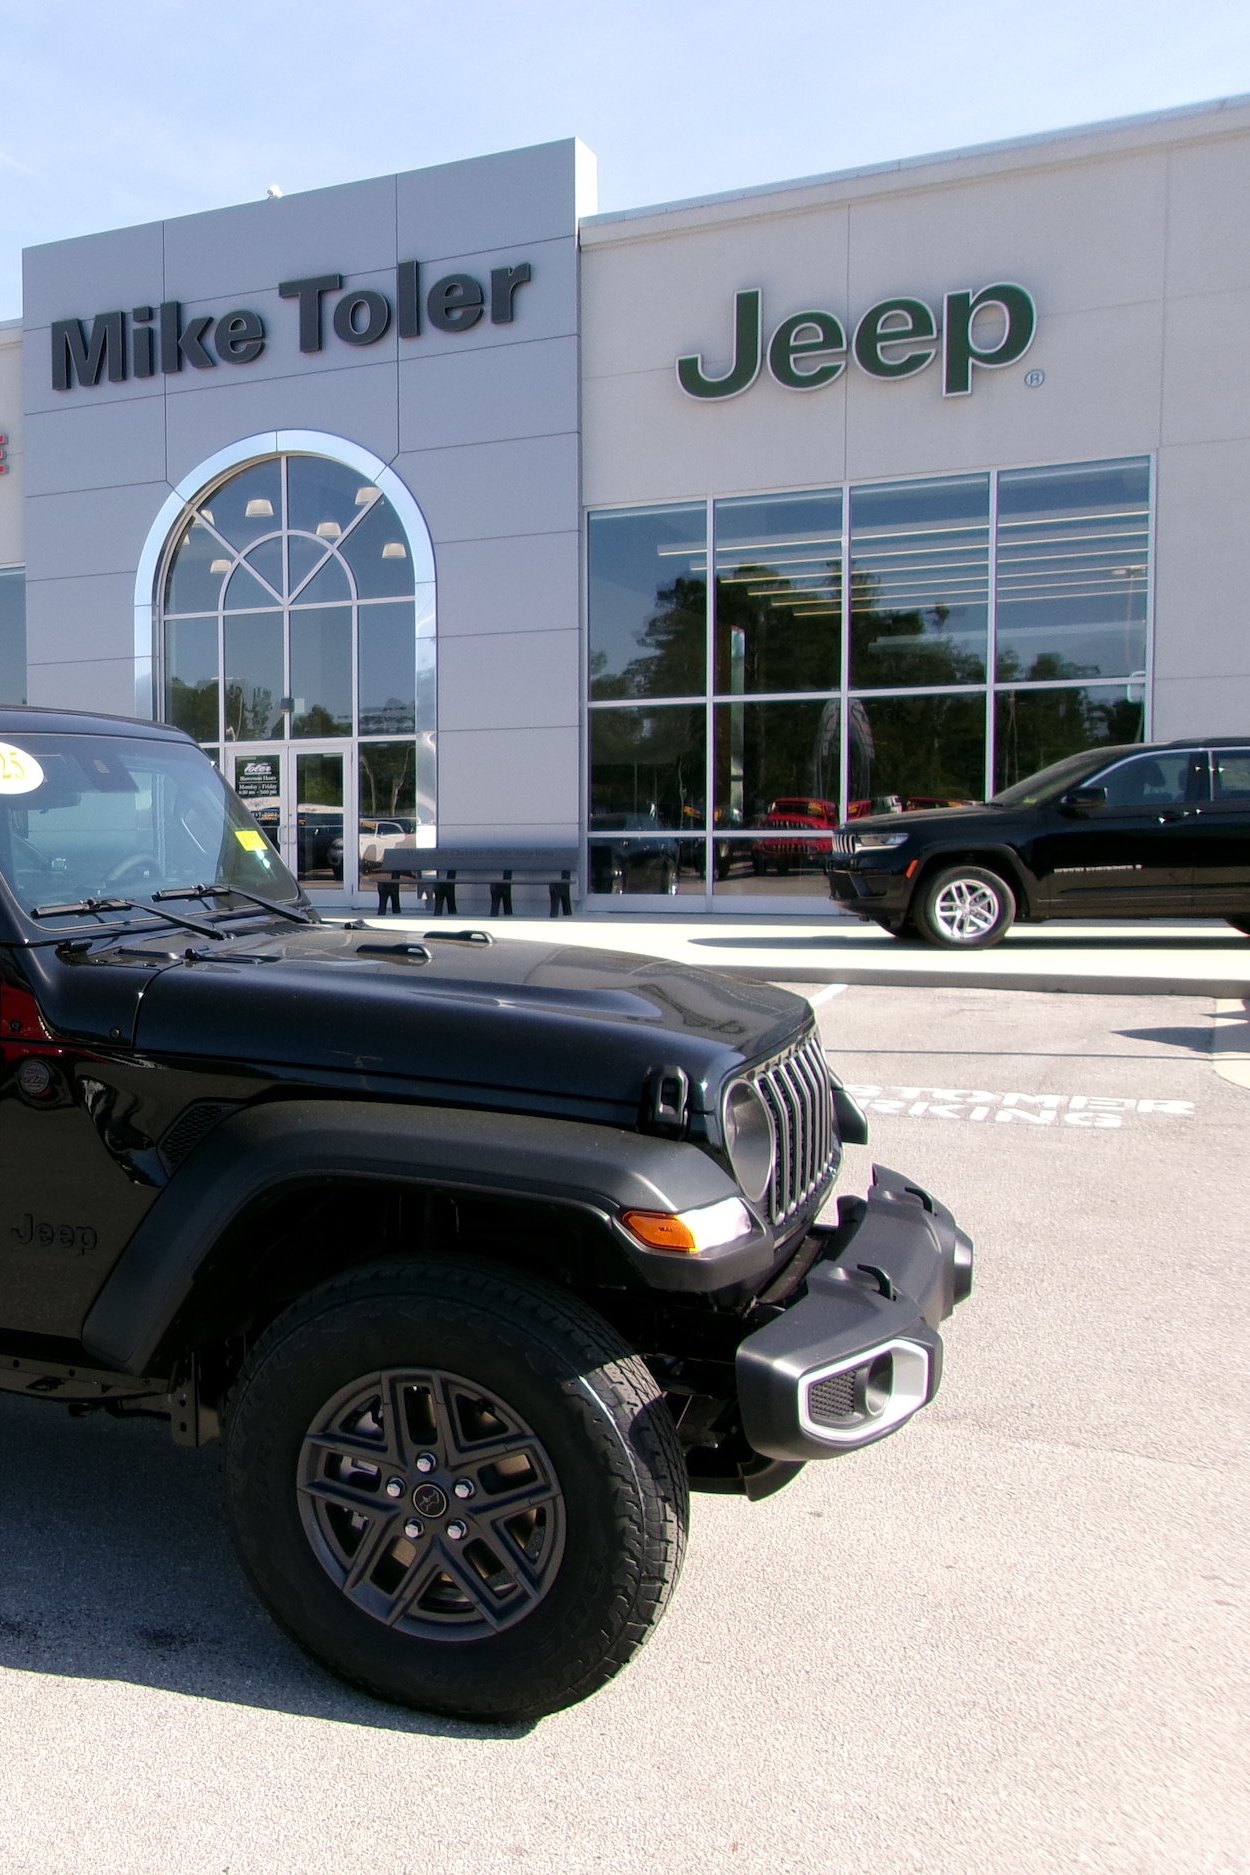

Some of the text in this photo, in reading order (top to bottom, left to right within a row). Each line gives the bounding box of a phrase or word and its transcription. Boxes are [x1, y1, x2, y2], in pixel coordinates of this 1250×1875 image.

[51, 260, 531, 391] Mike Toler
[676, 282, 1038, 401] Jeep
[844, 1084, 1196, 1115] STOMER
[10, 1213, 98, 1255] Jeep
